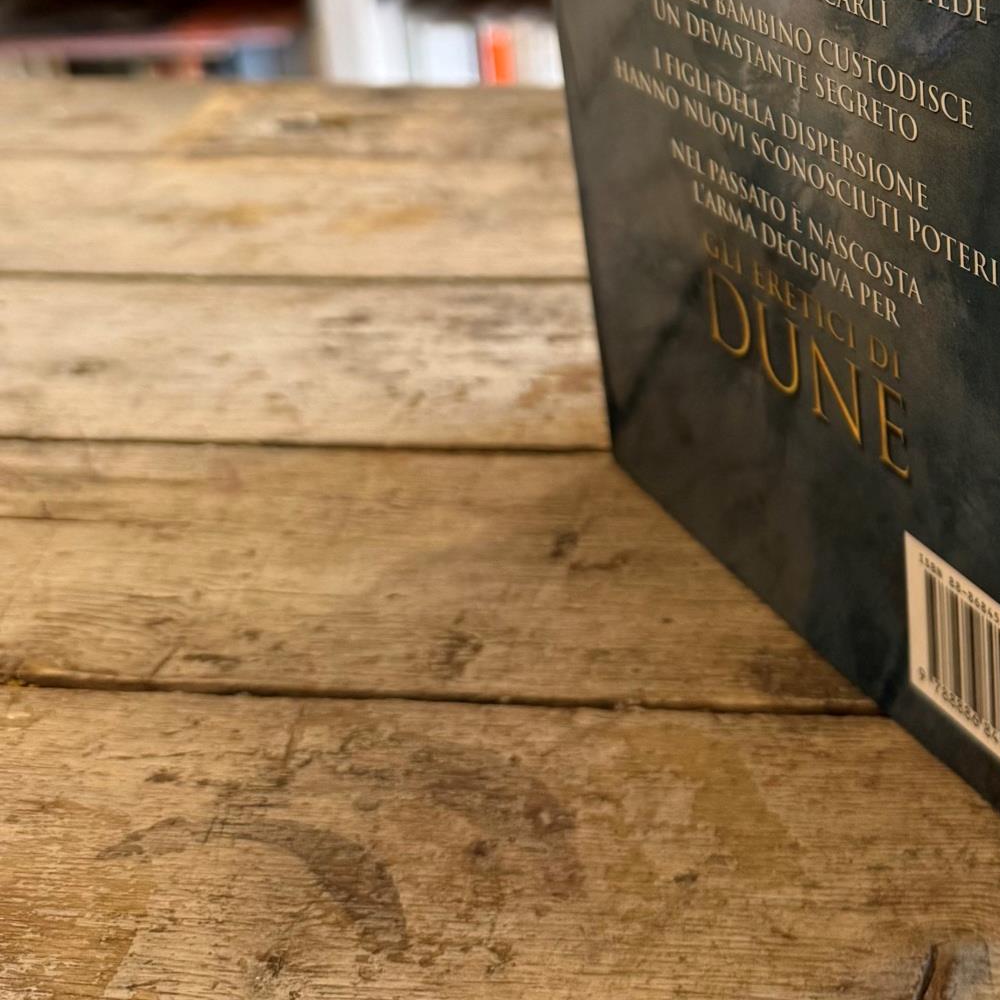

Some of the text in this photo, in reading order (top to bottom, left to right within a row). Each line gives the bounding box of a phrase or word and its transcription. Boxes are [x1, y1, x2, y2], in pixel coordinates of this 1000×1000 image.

[653, 46, 930, 211] I FIGLI DELLA DISPERSIONE
[684, 7, 809, 92] DEVASTANTE
[815, 72, 919, 142] SEGRETO
[818, 37, 975, 129] CUSTODISCE
[614, 55, 1000, 288] HANNO NUOVI SCONOSCIUTI POTERI
[670, 137, 924, 305] NEL PASSATO È NASCOSTA
[692, 180, 901, 328] L'ARMA DECISIVA PER
[703, 231, 901, 380] GLI ERETICI DI
[707, 266, 911, 480] DUNE
